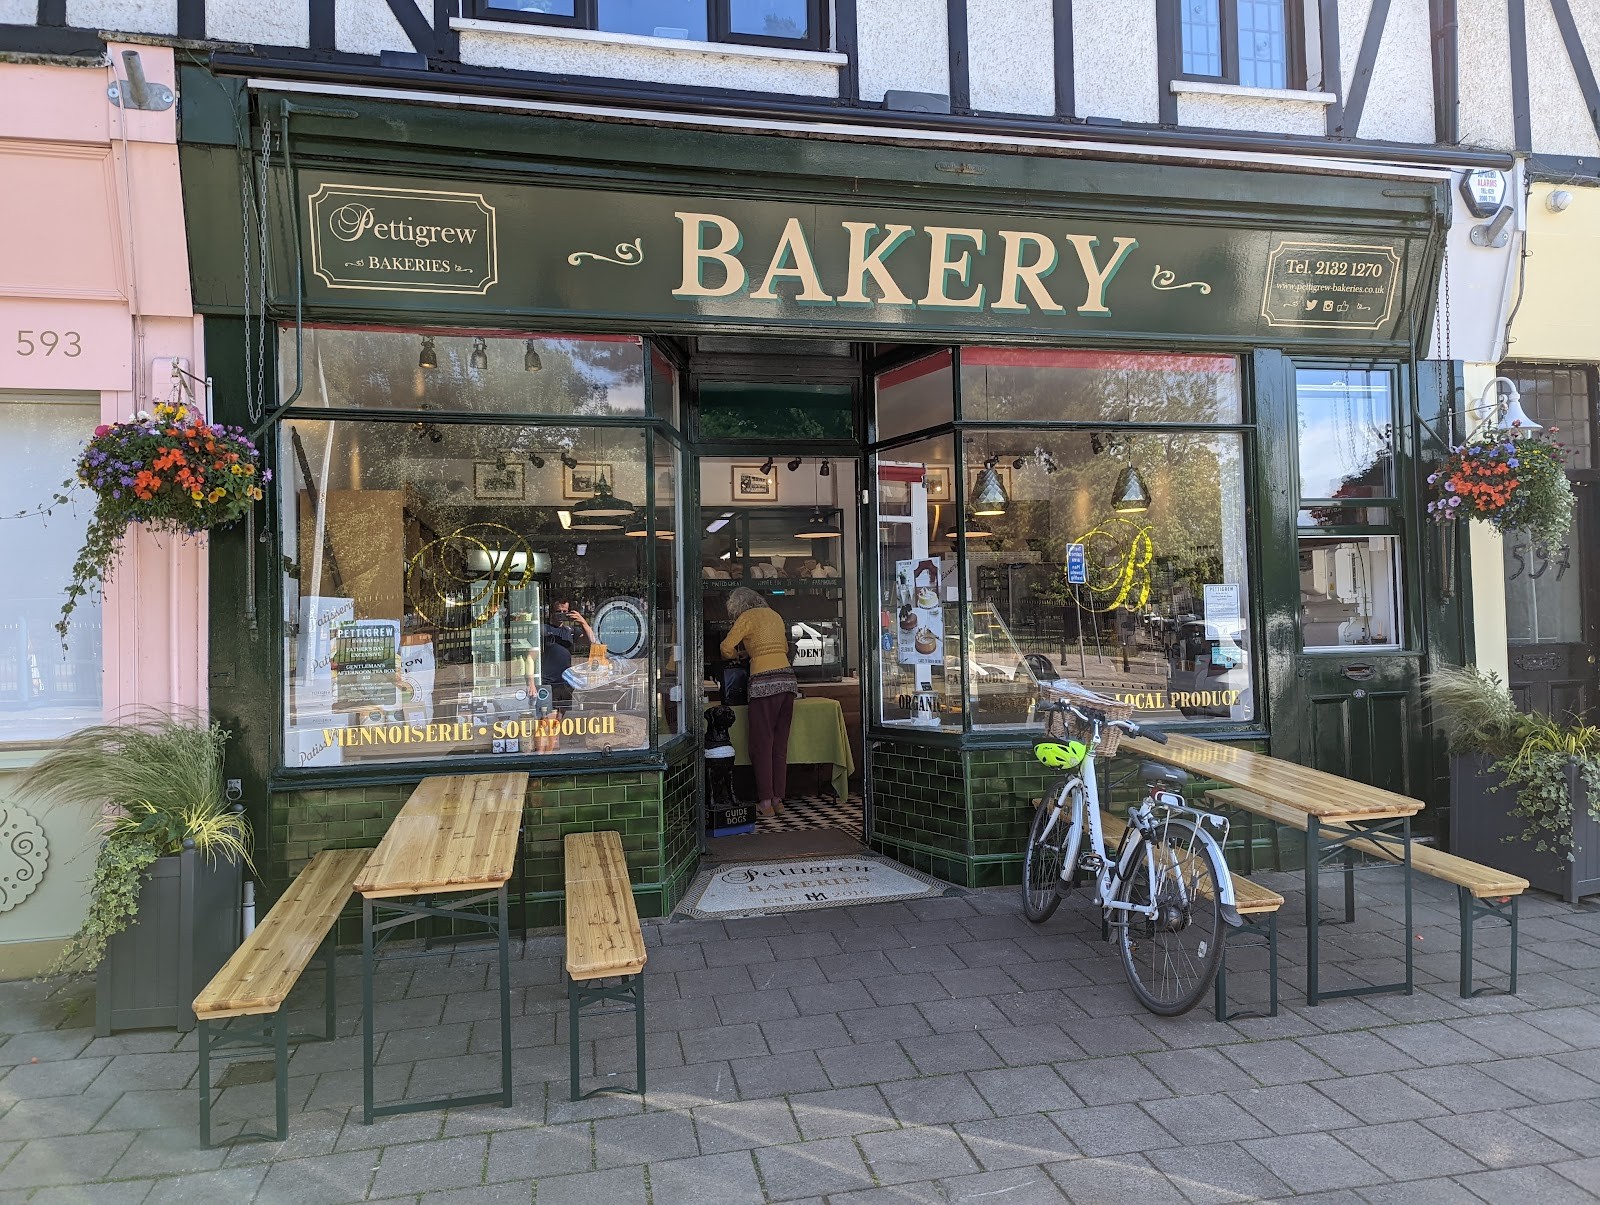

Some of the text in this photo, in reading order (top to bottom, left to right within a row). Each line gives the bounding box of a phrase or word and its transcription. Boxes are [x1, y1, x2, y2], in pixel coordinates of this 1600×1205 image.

[329, 203, 478, 248] Pettigrew
[368, 255, 451, 273] BAKERIES
[672, 211, 1140, 318] BAKERY
[1286, 259, 1383, 278] Tel. 2132 1270
[1276, 281, 1385, 295] www.pettigrew-bakeries.co.uk
[16, 330, 82, 358] 593
[1508, 543, 1572, 582] 597
[336, 627, 393, 639] PETTIGREW
[1114, 689, 1241, 709] LOCAL PRODUCE
[322, 723, 474, 748] VIENNOISERIE
[493, 716, 616, 739] SOURDOUGH
[725, 807, 748, 818] GUIDE
[726, 815, 747, 825] DOGS
[747, 875, 871, 893] BAKERIES
